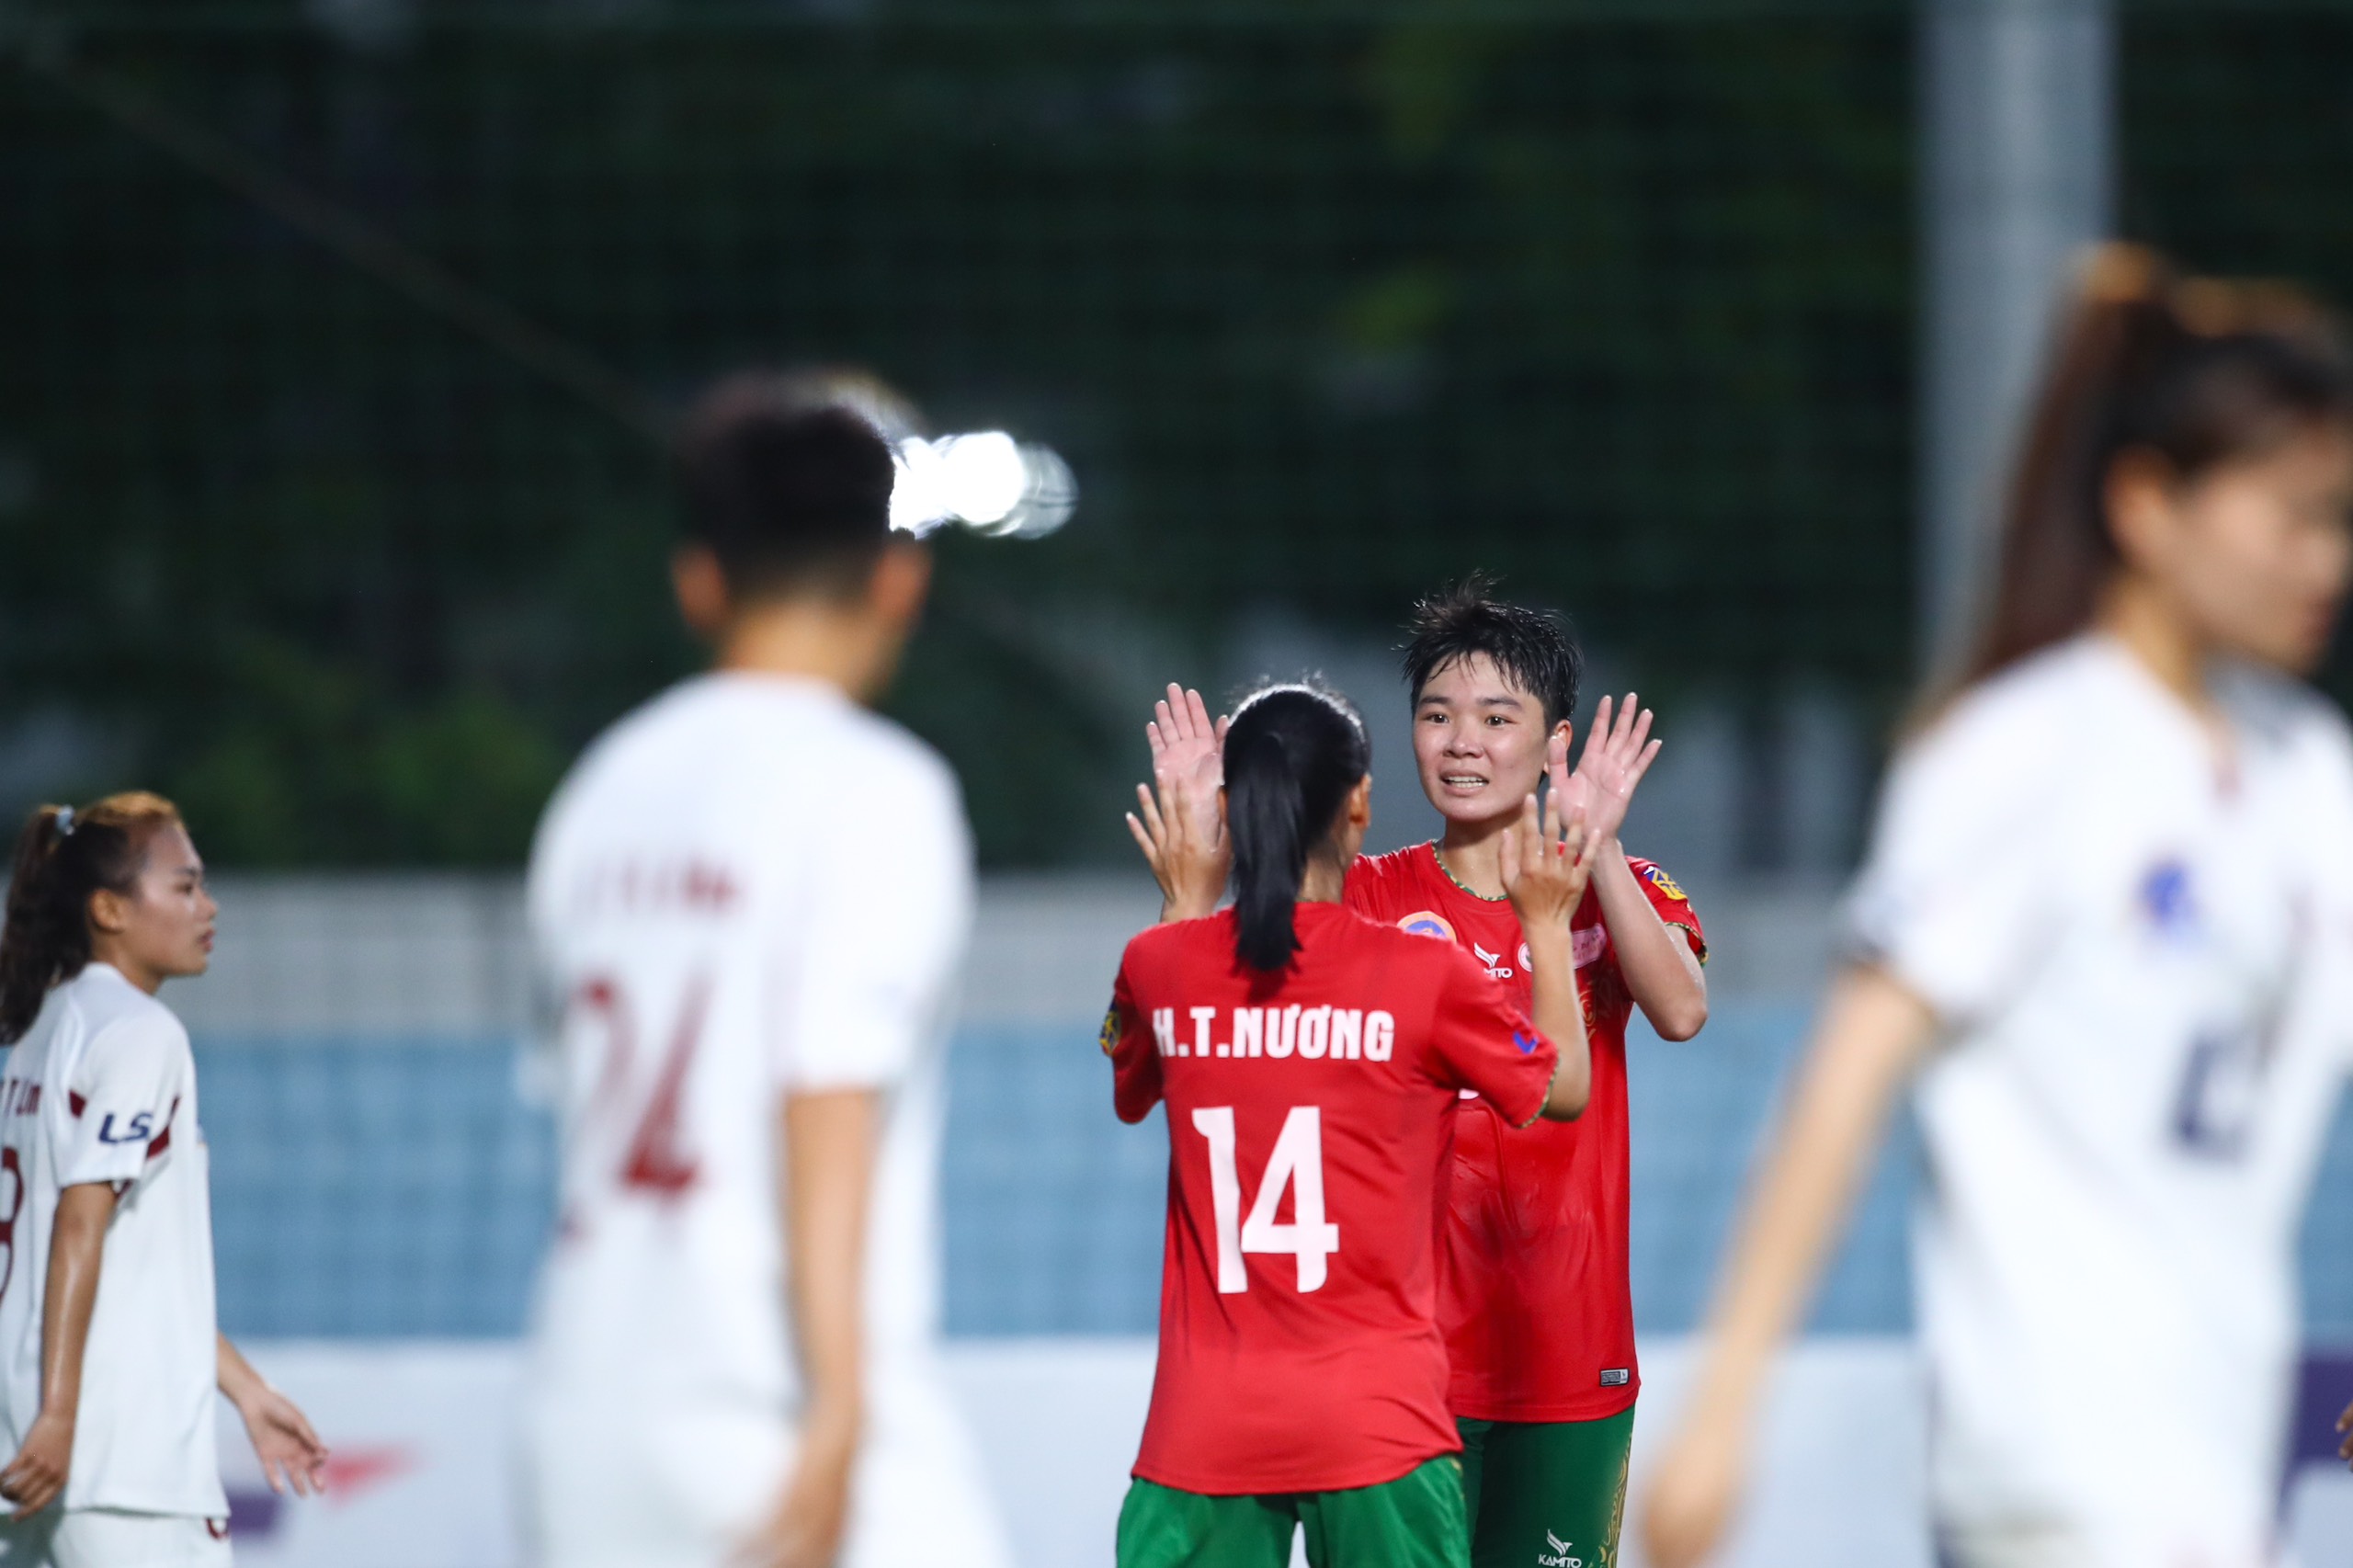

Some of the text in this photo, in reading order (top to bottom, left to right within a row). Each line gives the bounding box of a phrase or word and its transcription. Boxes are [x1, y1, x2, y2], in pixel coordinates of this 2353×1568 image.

[1483, 967, 1513, 979] MITO
[1153, 1003, 1395, 1062] H.T.NƯƠNG
[98, 1111, 153, 1144] LS
[1191, 1106, 1340, 1294] 14
[1538, 1553, 1582, 1568] KAMITO
